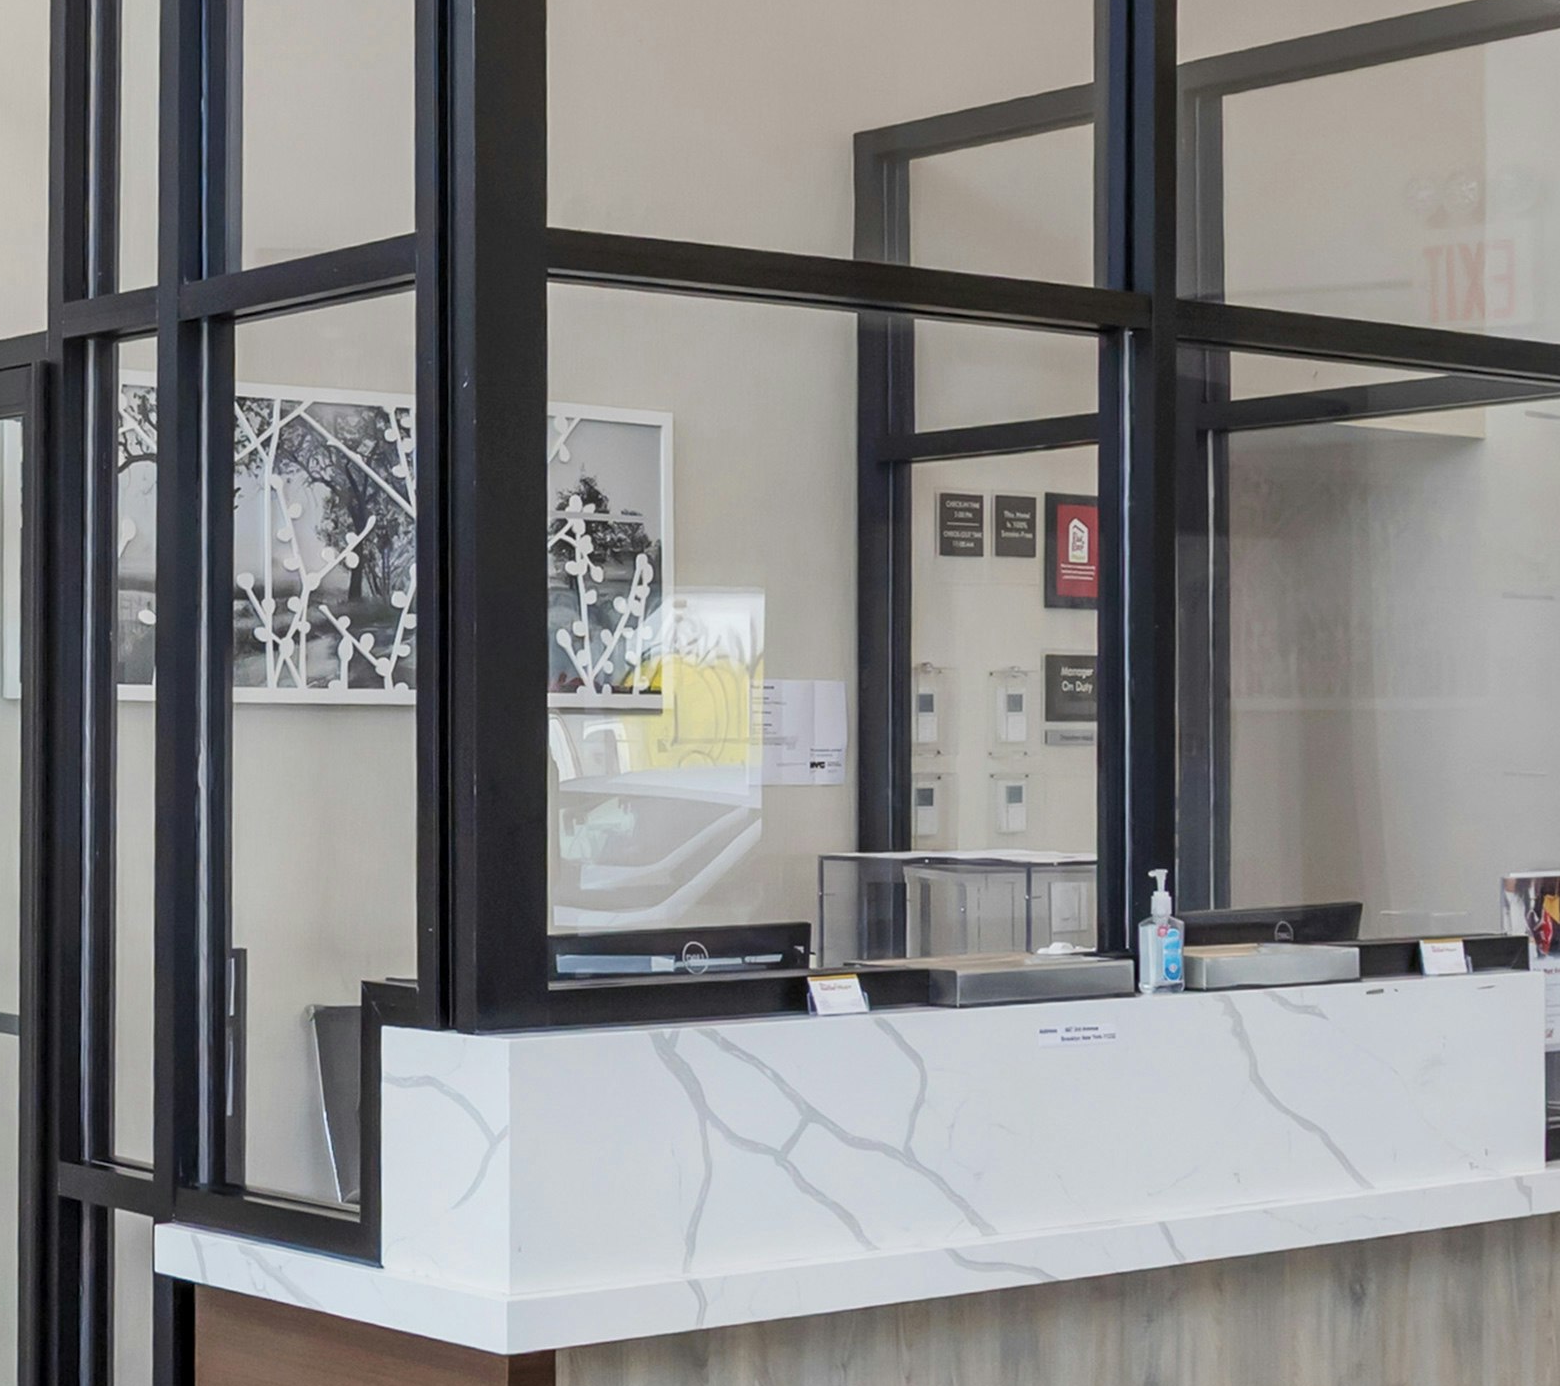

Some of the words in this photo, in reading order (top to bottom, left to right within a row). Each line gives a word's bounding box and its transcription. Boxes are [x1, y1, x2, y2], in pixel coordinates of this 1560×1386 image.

[1060, 666, 1093, 679] Manager
[1061, 680, 1074, 692] On
[1075, 680, 1093, 693] Duty
